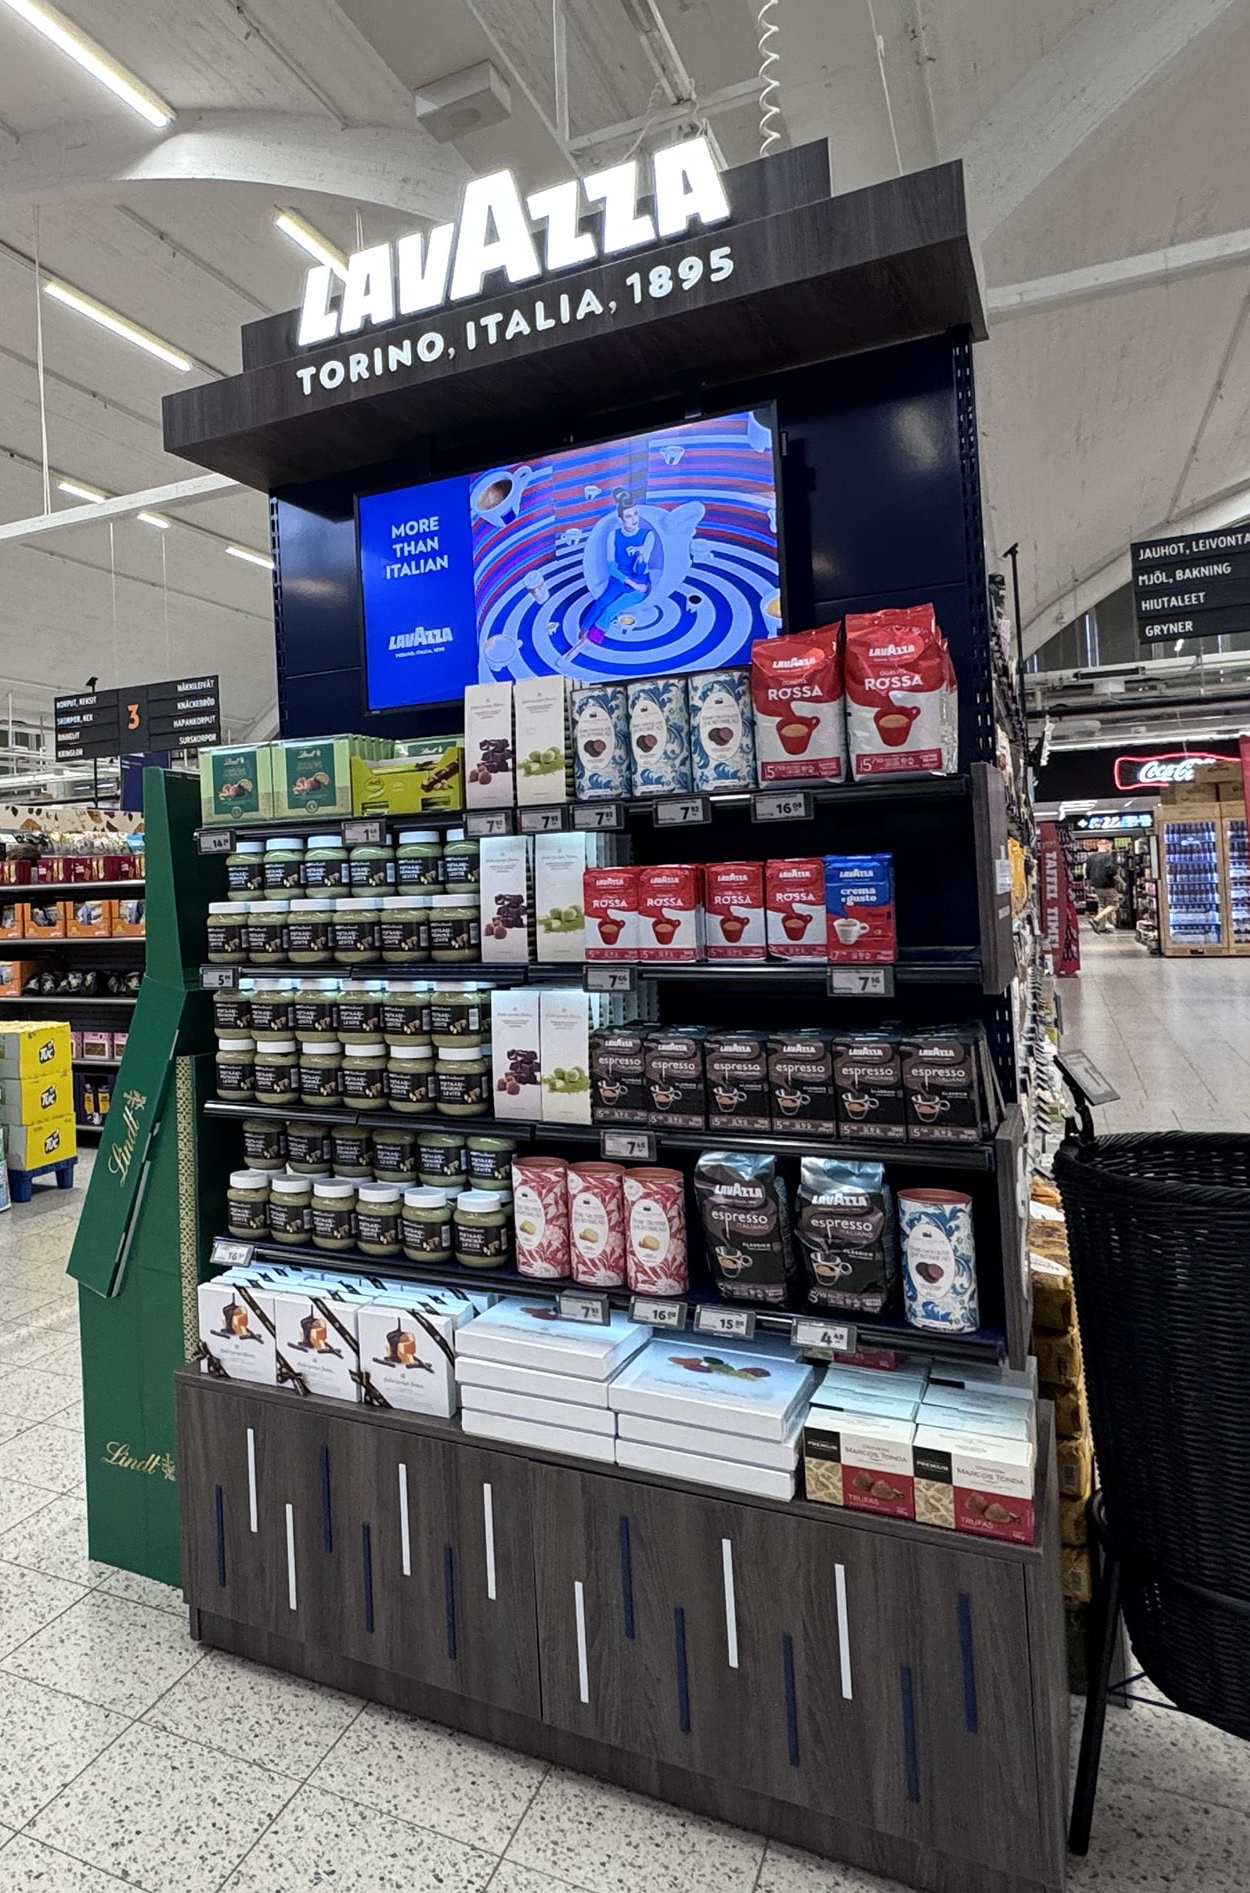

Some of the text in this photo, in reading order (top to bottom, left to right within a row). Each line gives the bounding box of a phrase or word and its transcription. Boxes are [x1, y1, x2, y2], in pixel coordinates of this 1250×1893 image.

[297, 135, 731, 346] LAVAZZA
[296, 246, 735, 396] TORINO, ITALIA, 1895
[391, 516, 440, 539] MORE
[392, 536, 439, 558] THAN
[1138, 542, 1190, 560] JAUHOT,
[386, 554, 449, 580] ITALIAN
[1138, 562, 1232, 586] MJÖL, BAKNING
[1141, 591, 1206, 611] HIUTALEET
[1145, 620, 1194, 637] GRYNER
[388, 626, 454, 651] LAVAZZA
[868, 643, 916, 657] LAVAZZA
[772, 656, 817, 669] LAVAZZA
[864, 673, 924, 691] ROSSA
[768, 686, 823, 701] ROSSA
[127, 704, 140, 730] 3
[1046, 851, 1058, 900] TAFFEL
[776, 891, 815, 903] ROSSA
[840, 887, 876, 896] crema
[593, 897, 628, 908] ROSSA
[646, 897, 684, 908] ROSSA
[714, 894, 752, 905] ROSSA
[846, 894, 877, 906] gusto
[599, 1057, 641, 1070] espresso
[652, 1061, 695, 1073] espresso
[713, 1062, 761, 1075] espresso
[776, 1064, 825, 1077] espresso
[842, 1067, 893, 1080] espresso
[911, 1067, 965, 1081] espresso
[108, 1105, 140, 1187] Lindt
[714, 1182, 763, 1198] LAVAZZA
[811, 1193, 868, 1206] LAVAZZA
[711, 1210, 768, 1230] espresso
[811, 1218, 873, 1236] espresso
[101, 1441, 162, 1475] Lindt
[879, 1452, 908, 1464] TONDA
[957, 1467, 993, 1480] MARCOS
[996, 1474, 1025, 1486] TONDA
[848, 1493, 880, 1506] TRUFAS
[960, 1516, 994, 1529] TRUFAS
